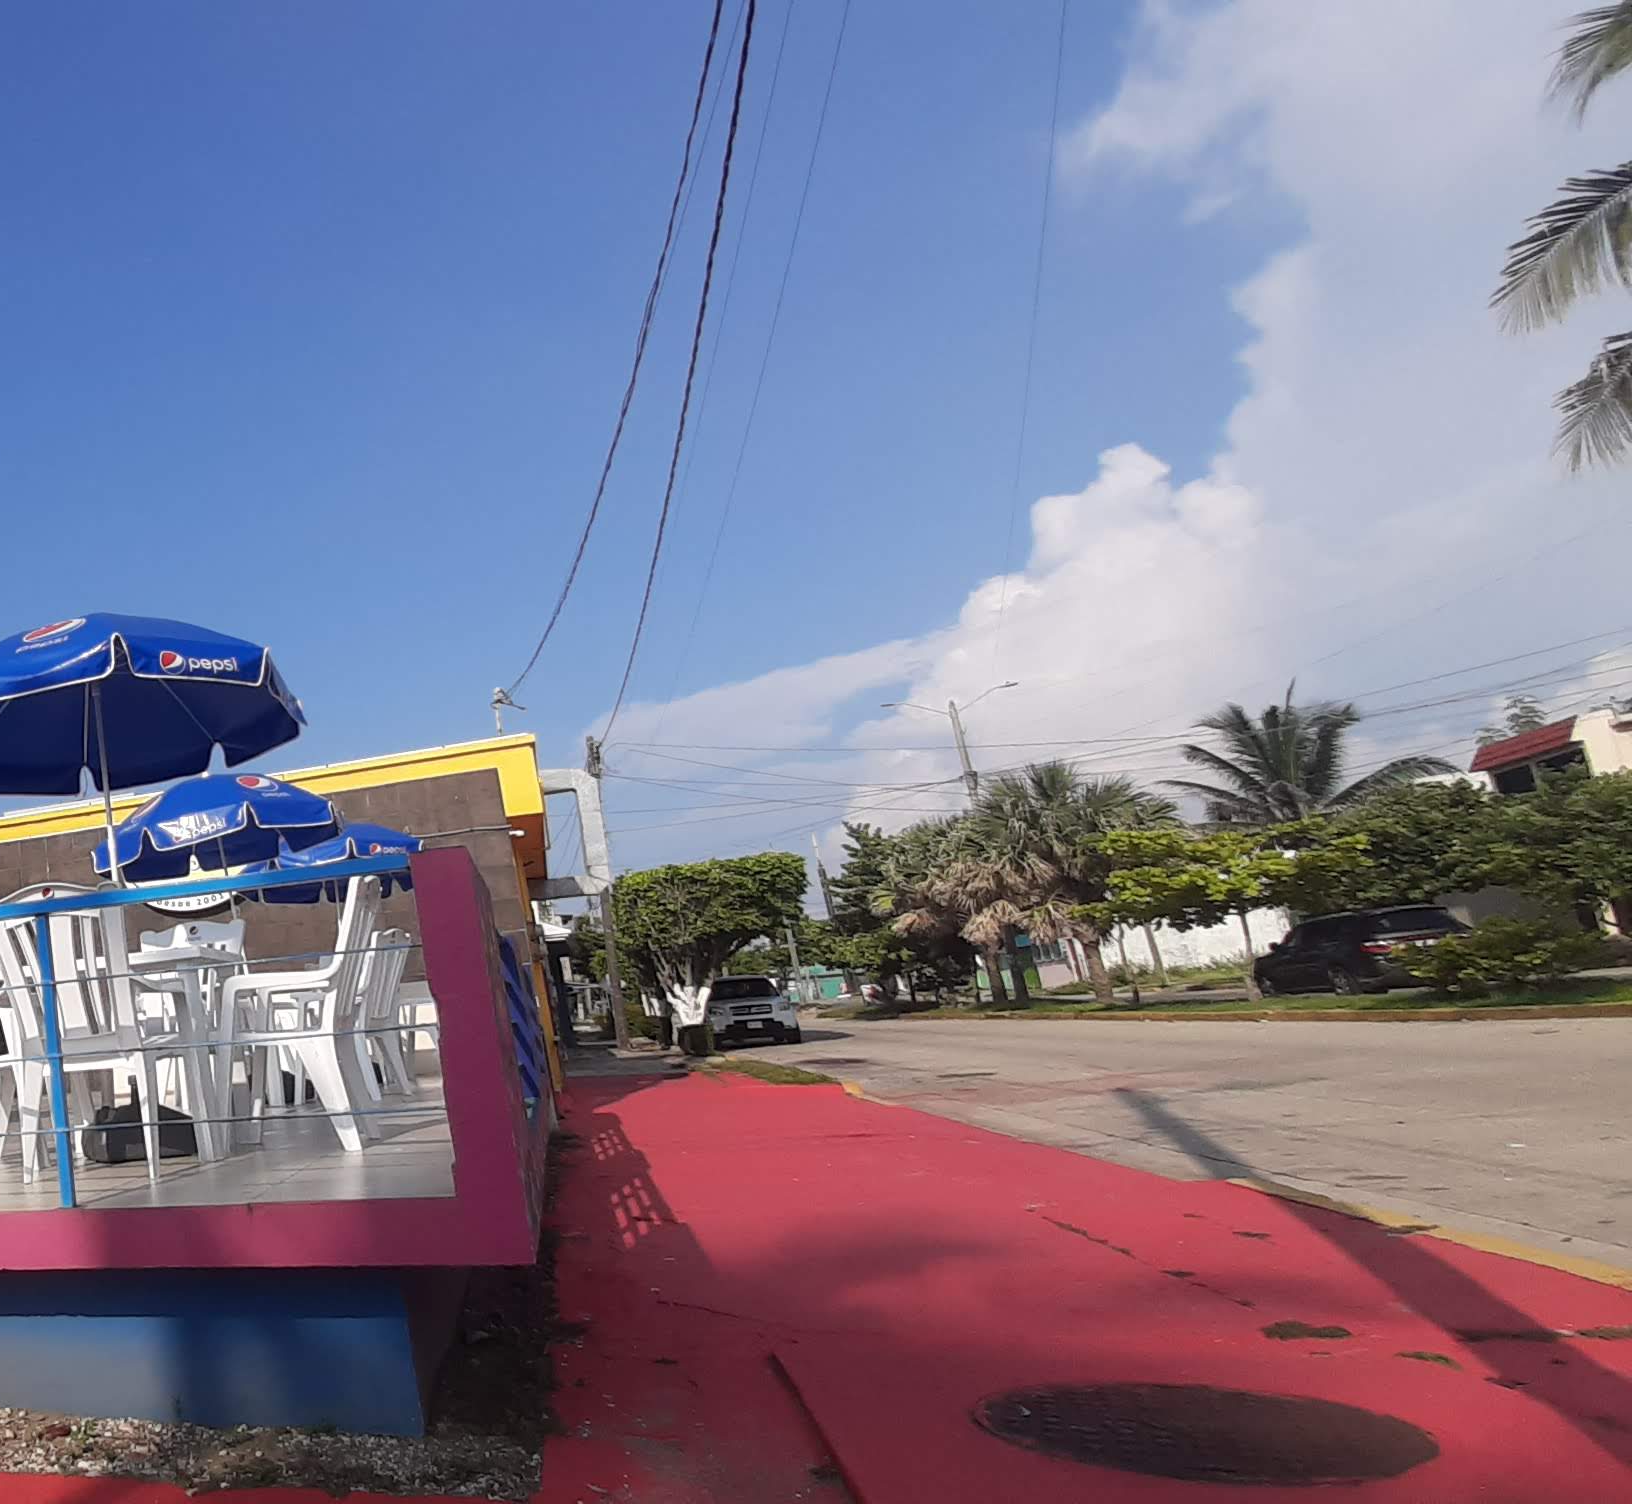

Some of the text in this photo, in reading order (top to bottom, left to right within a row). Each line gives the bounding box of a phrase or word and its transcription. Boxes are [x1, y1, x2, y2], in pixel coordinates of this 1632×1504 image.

[188, 656, 238, 674] pepsi
[192, 815, 226, 839] pepsi
[196, 892, 224, 905] 2001
